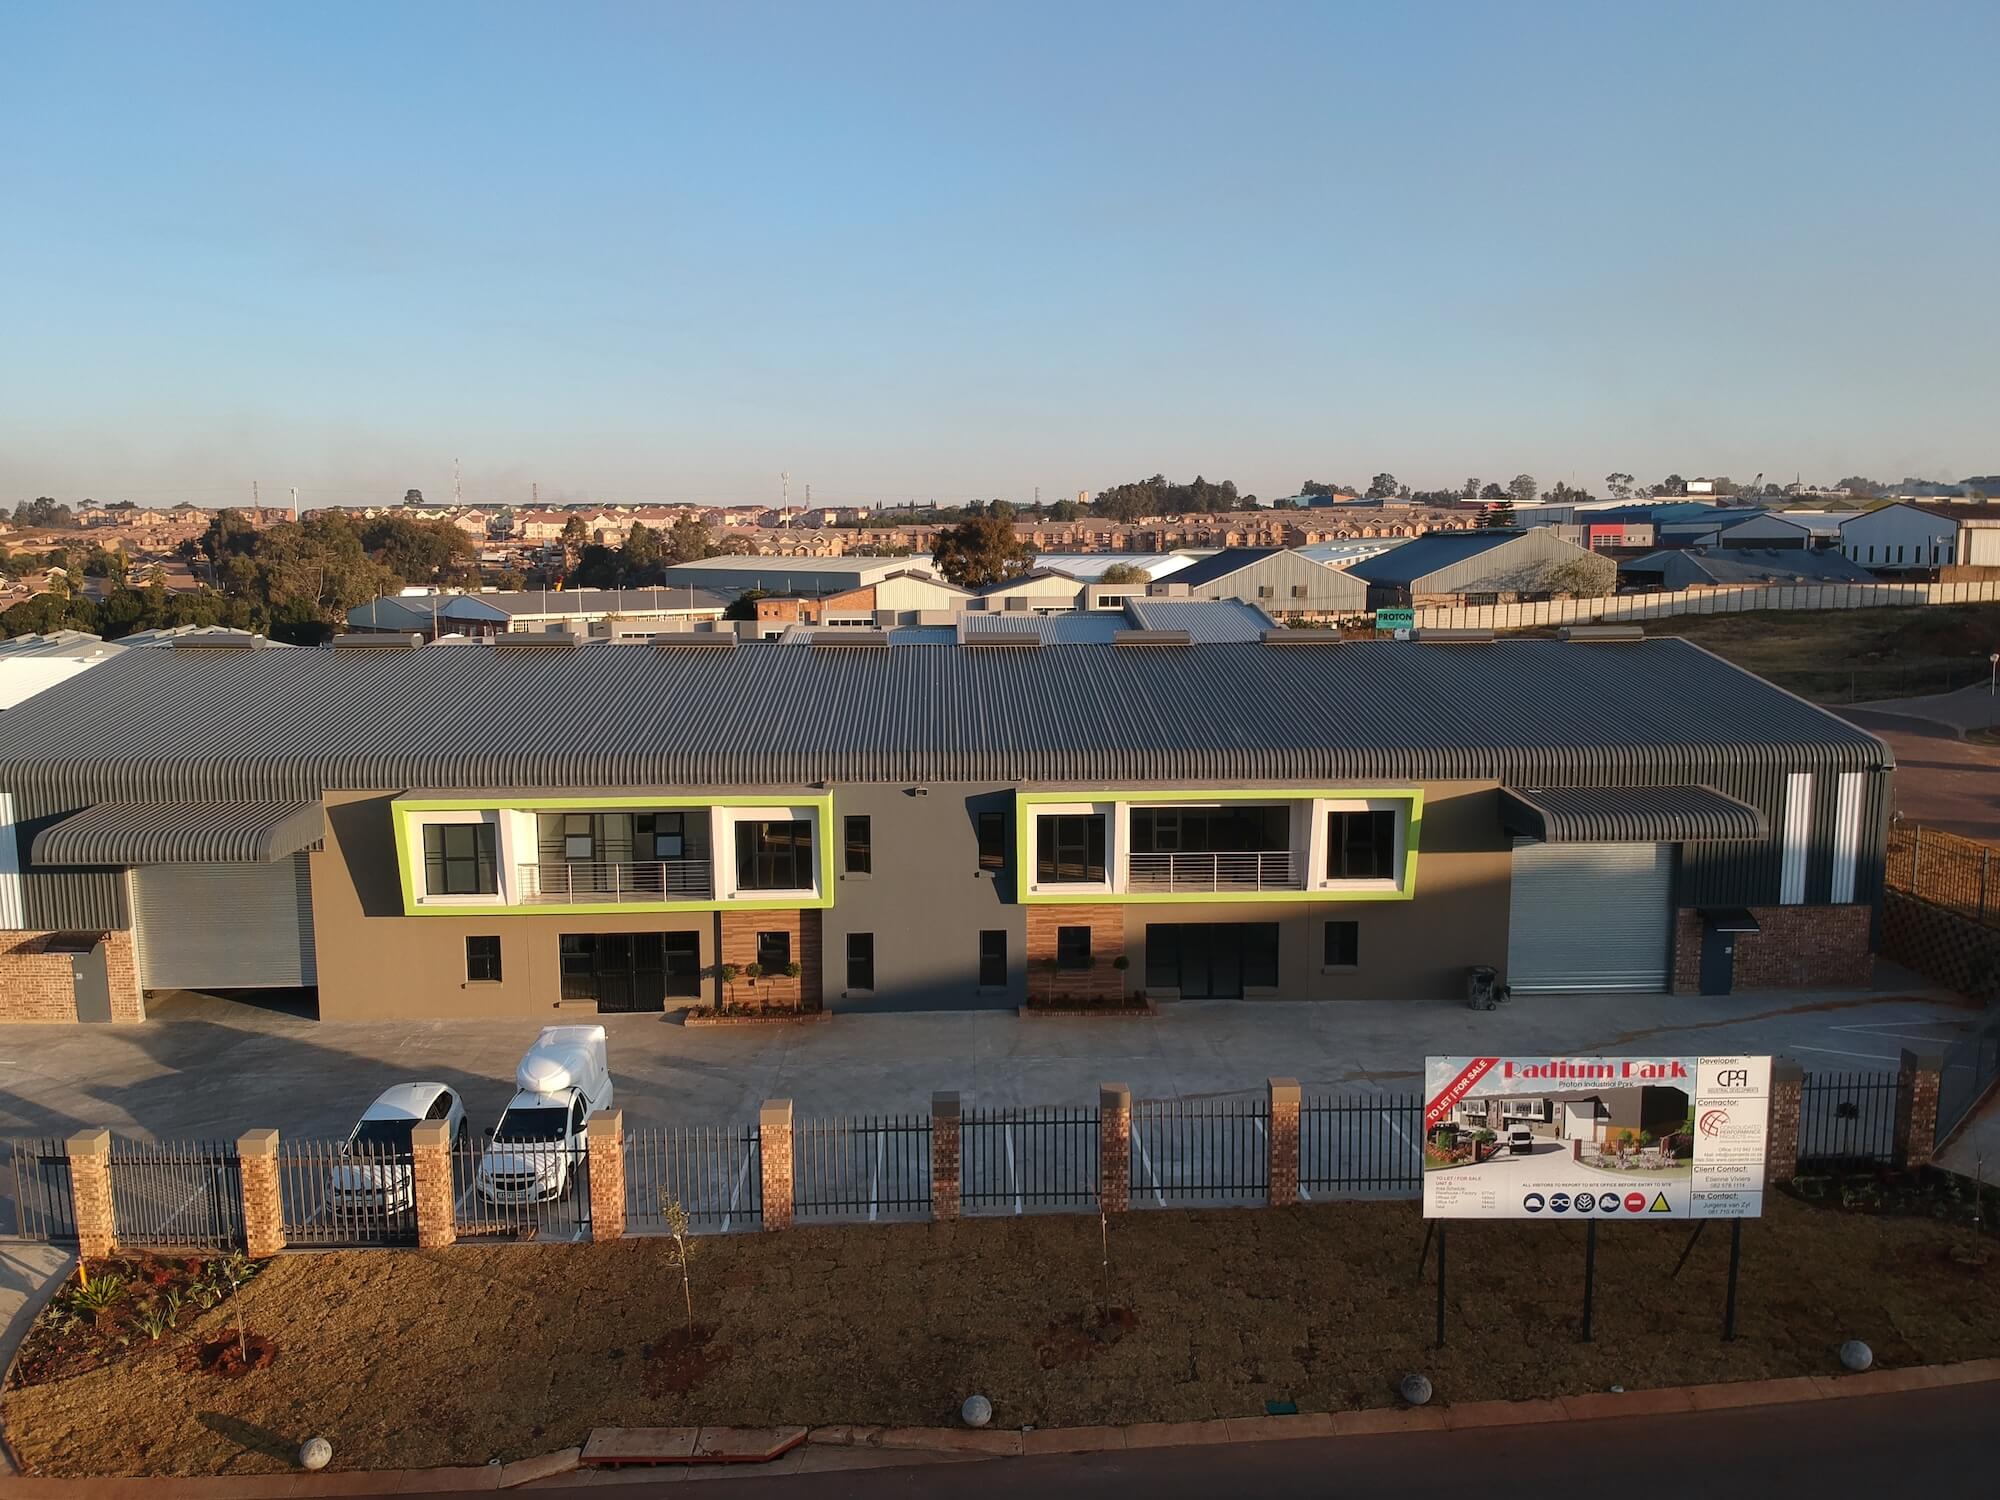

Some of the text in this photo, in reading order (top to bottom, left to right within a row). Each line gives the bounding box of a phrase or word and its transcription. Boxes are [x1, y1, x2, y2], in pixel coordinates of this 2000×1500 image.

[1378, 613, 1412, 621] PROTON
[1504, 1061, 1687, 1079] Radium Park
[1427, 1059, 1488, 1120] TO LET FOR SALE
[1583, 1080, 1616, 1088] Industrial
[1617, 1080, 1634, 1088] Park
